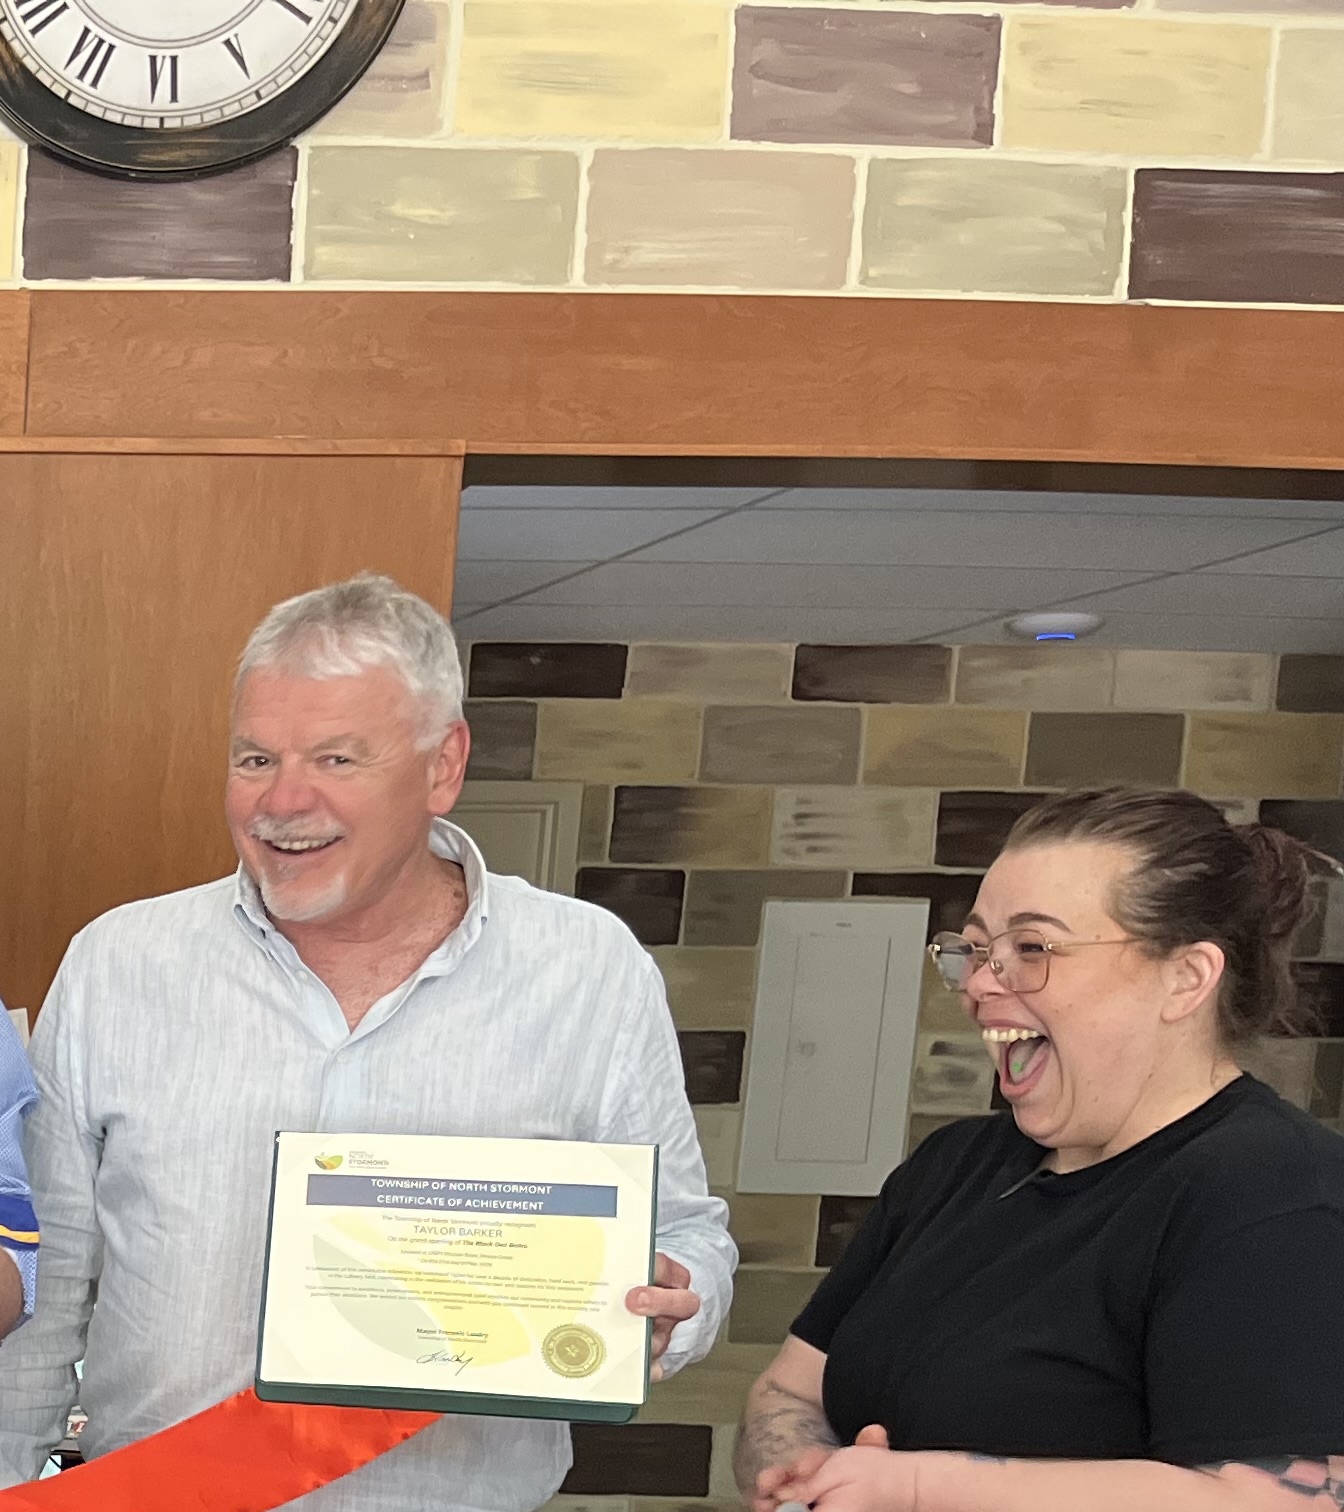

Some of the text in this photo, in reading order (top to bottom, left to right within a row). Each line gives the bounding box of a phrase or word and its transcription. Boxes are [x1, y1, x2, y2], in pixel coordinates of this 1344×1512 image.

[221, 33, 251, 80] V
[148, 54, 179, 104] VI
[370, 1178, 552, 1194] TOWNSHIP OF NORTH STORMONT
[376, 1194, 543, 1210] CERTIFICATE OF ACHIEVEMENT
[413, 1224, 502, 1237] TAYLOR BARKER
